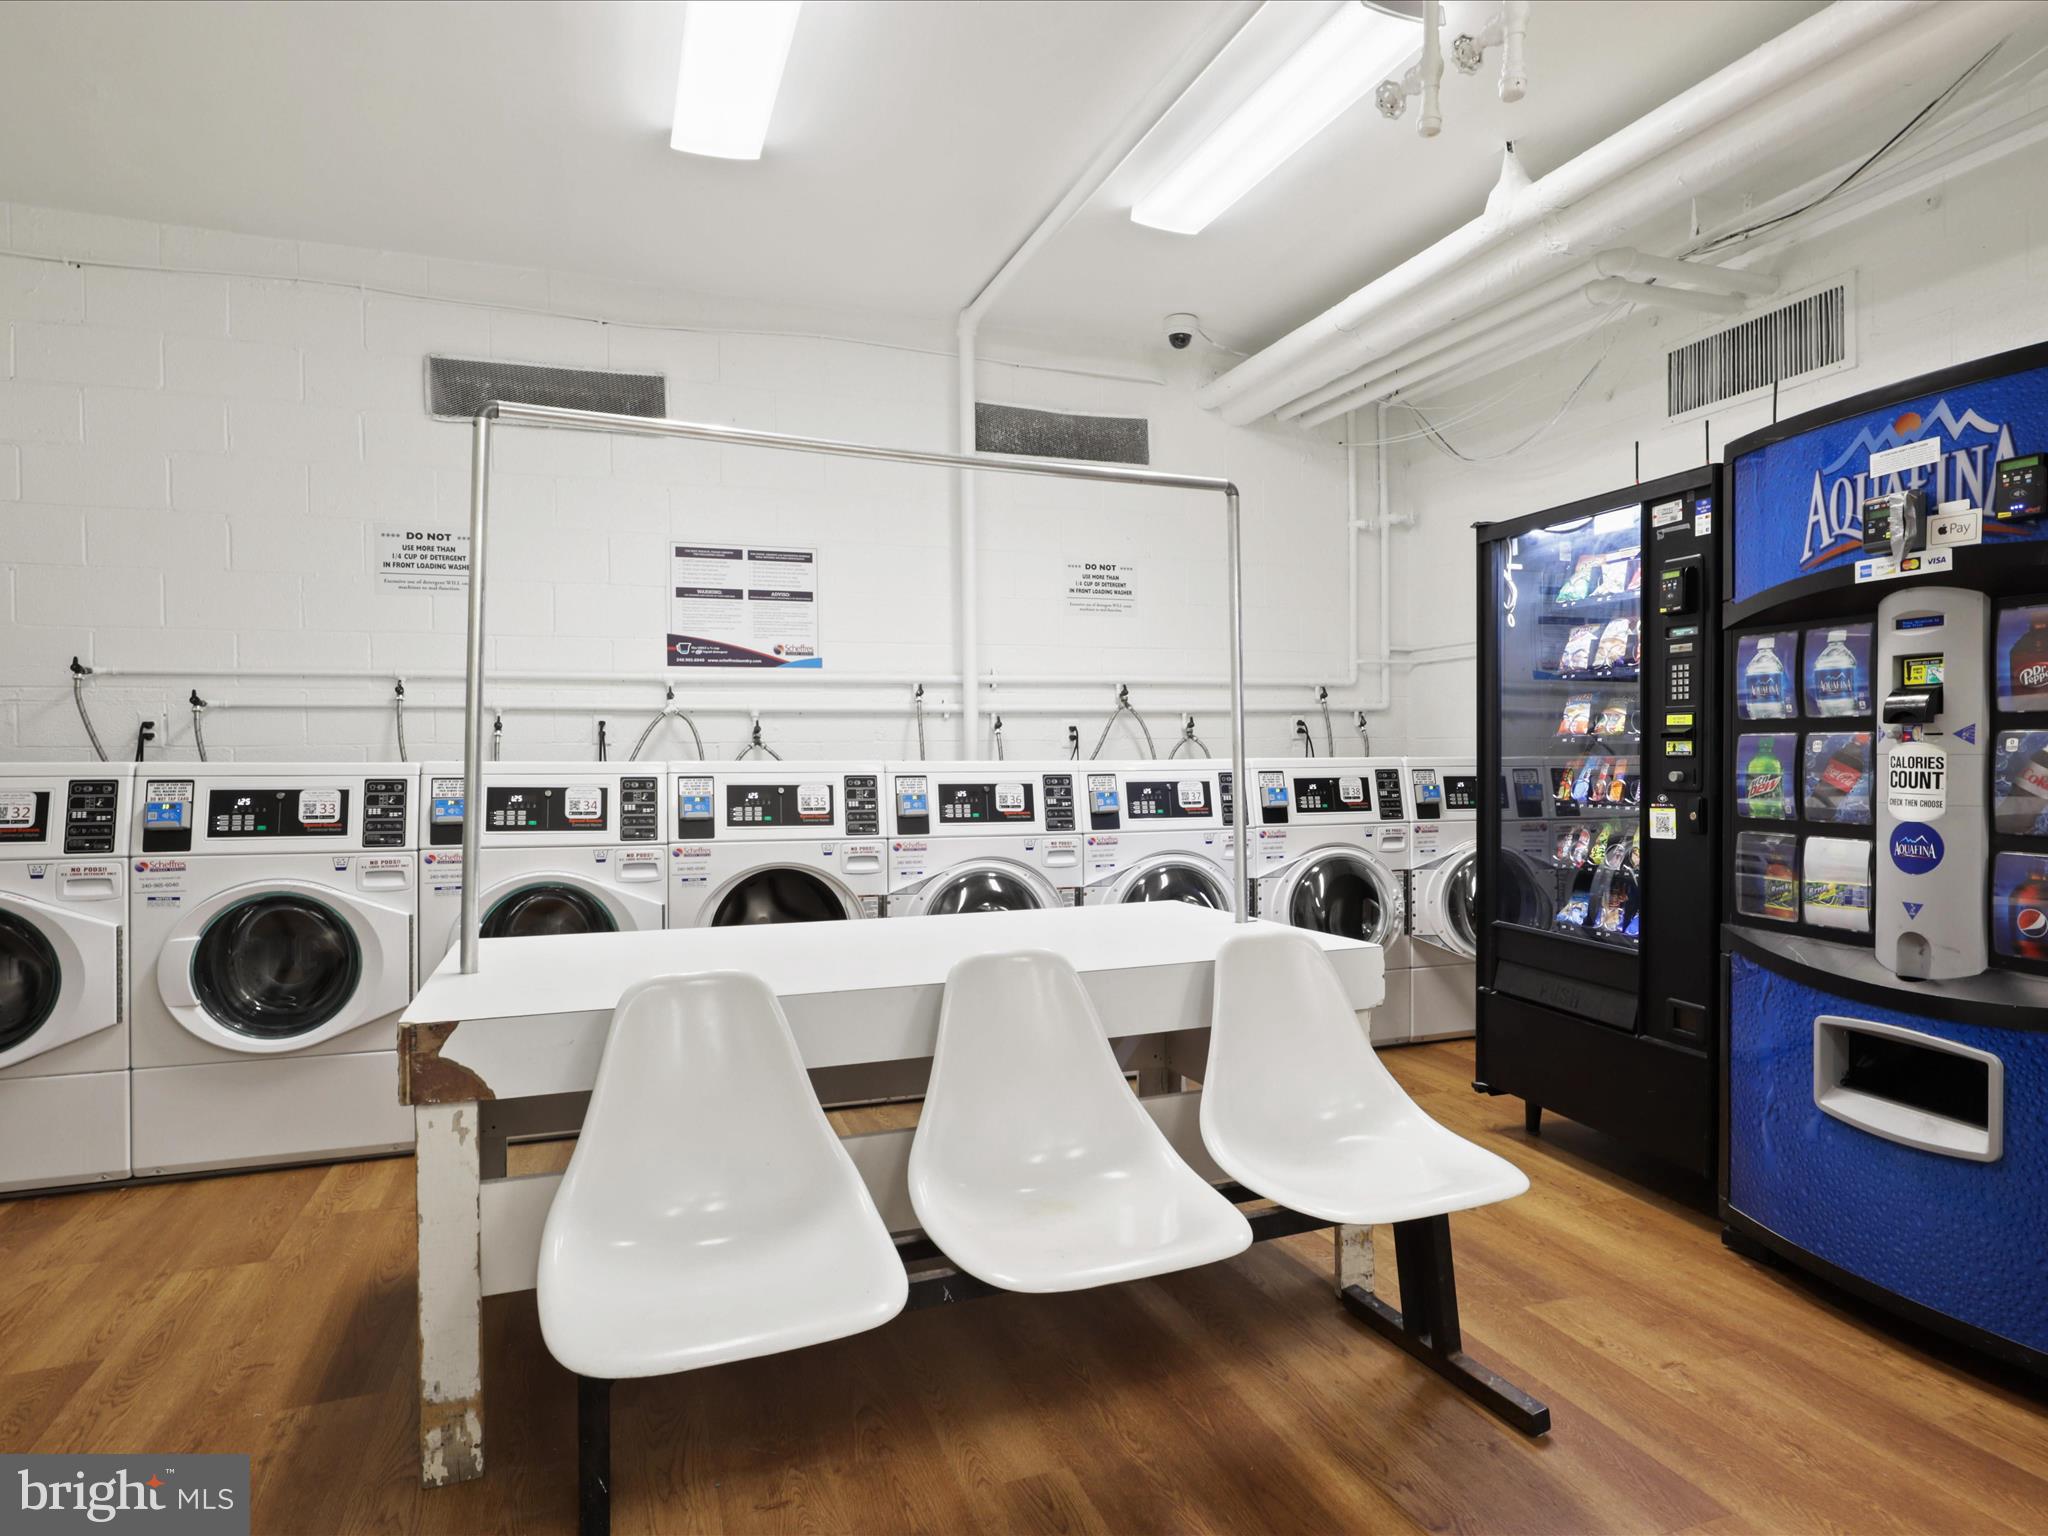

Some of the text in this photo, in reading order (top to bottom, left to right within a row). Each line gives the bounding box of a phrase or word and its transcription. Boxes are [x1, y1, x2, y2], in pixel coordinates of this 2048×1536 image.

[1950, 523, 1971, 534] Pay
[406, 532, 452, 541] DO NOT
[430, 554, 466, 562] DETERGENT
[1928, 556, 1946, 565] VISA
[416, 562, 446, 570] LOADING
[447, 563, 470, 571] WASHE
[2032, 665, 2047, 676] Dr
[1751, 684, 1779, 695] AQUAFINA
[1820, 679, 1852, 692] AQUAFINA
[1890, 756, 1944, 769] CALORIES
[1890, 770, 1944, 789] COUNT
[1191, 791, 1201, 800] 37
[1351, 787, 1361, 796] 38
[813, 797, 826, 806] 35
[1010, 795, 1022, 804] 36
[1889, 798, 1943, 808] CHECK THEN CHOOSE
[320, 803, 336, 814] 33
[583, 801, 597, 810] 34
[11, 806, 30, 818] 32
[1894, 841, 1937, 859] AQUAFINA
[437, 853, 463, 862] Scheffr
[150, 860, 186, 868] Scheffres
